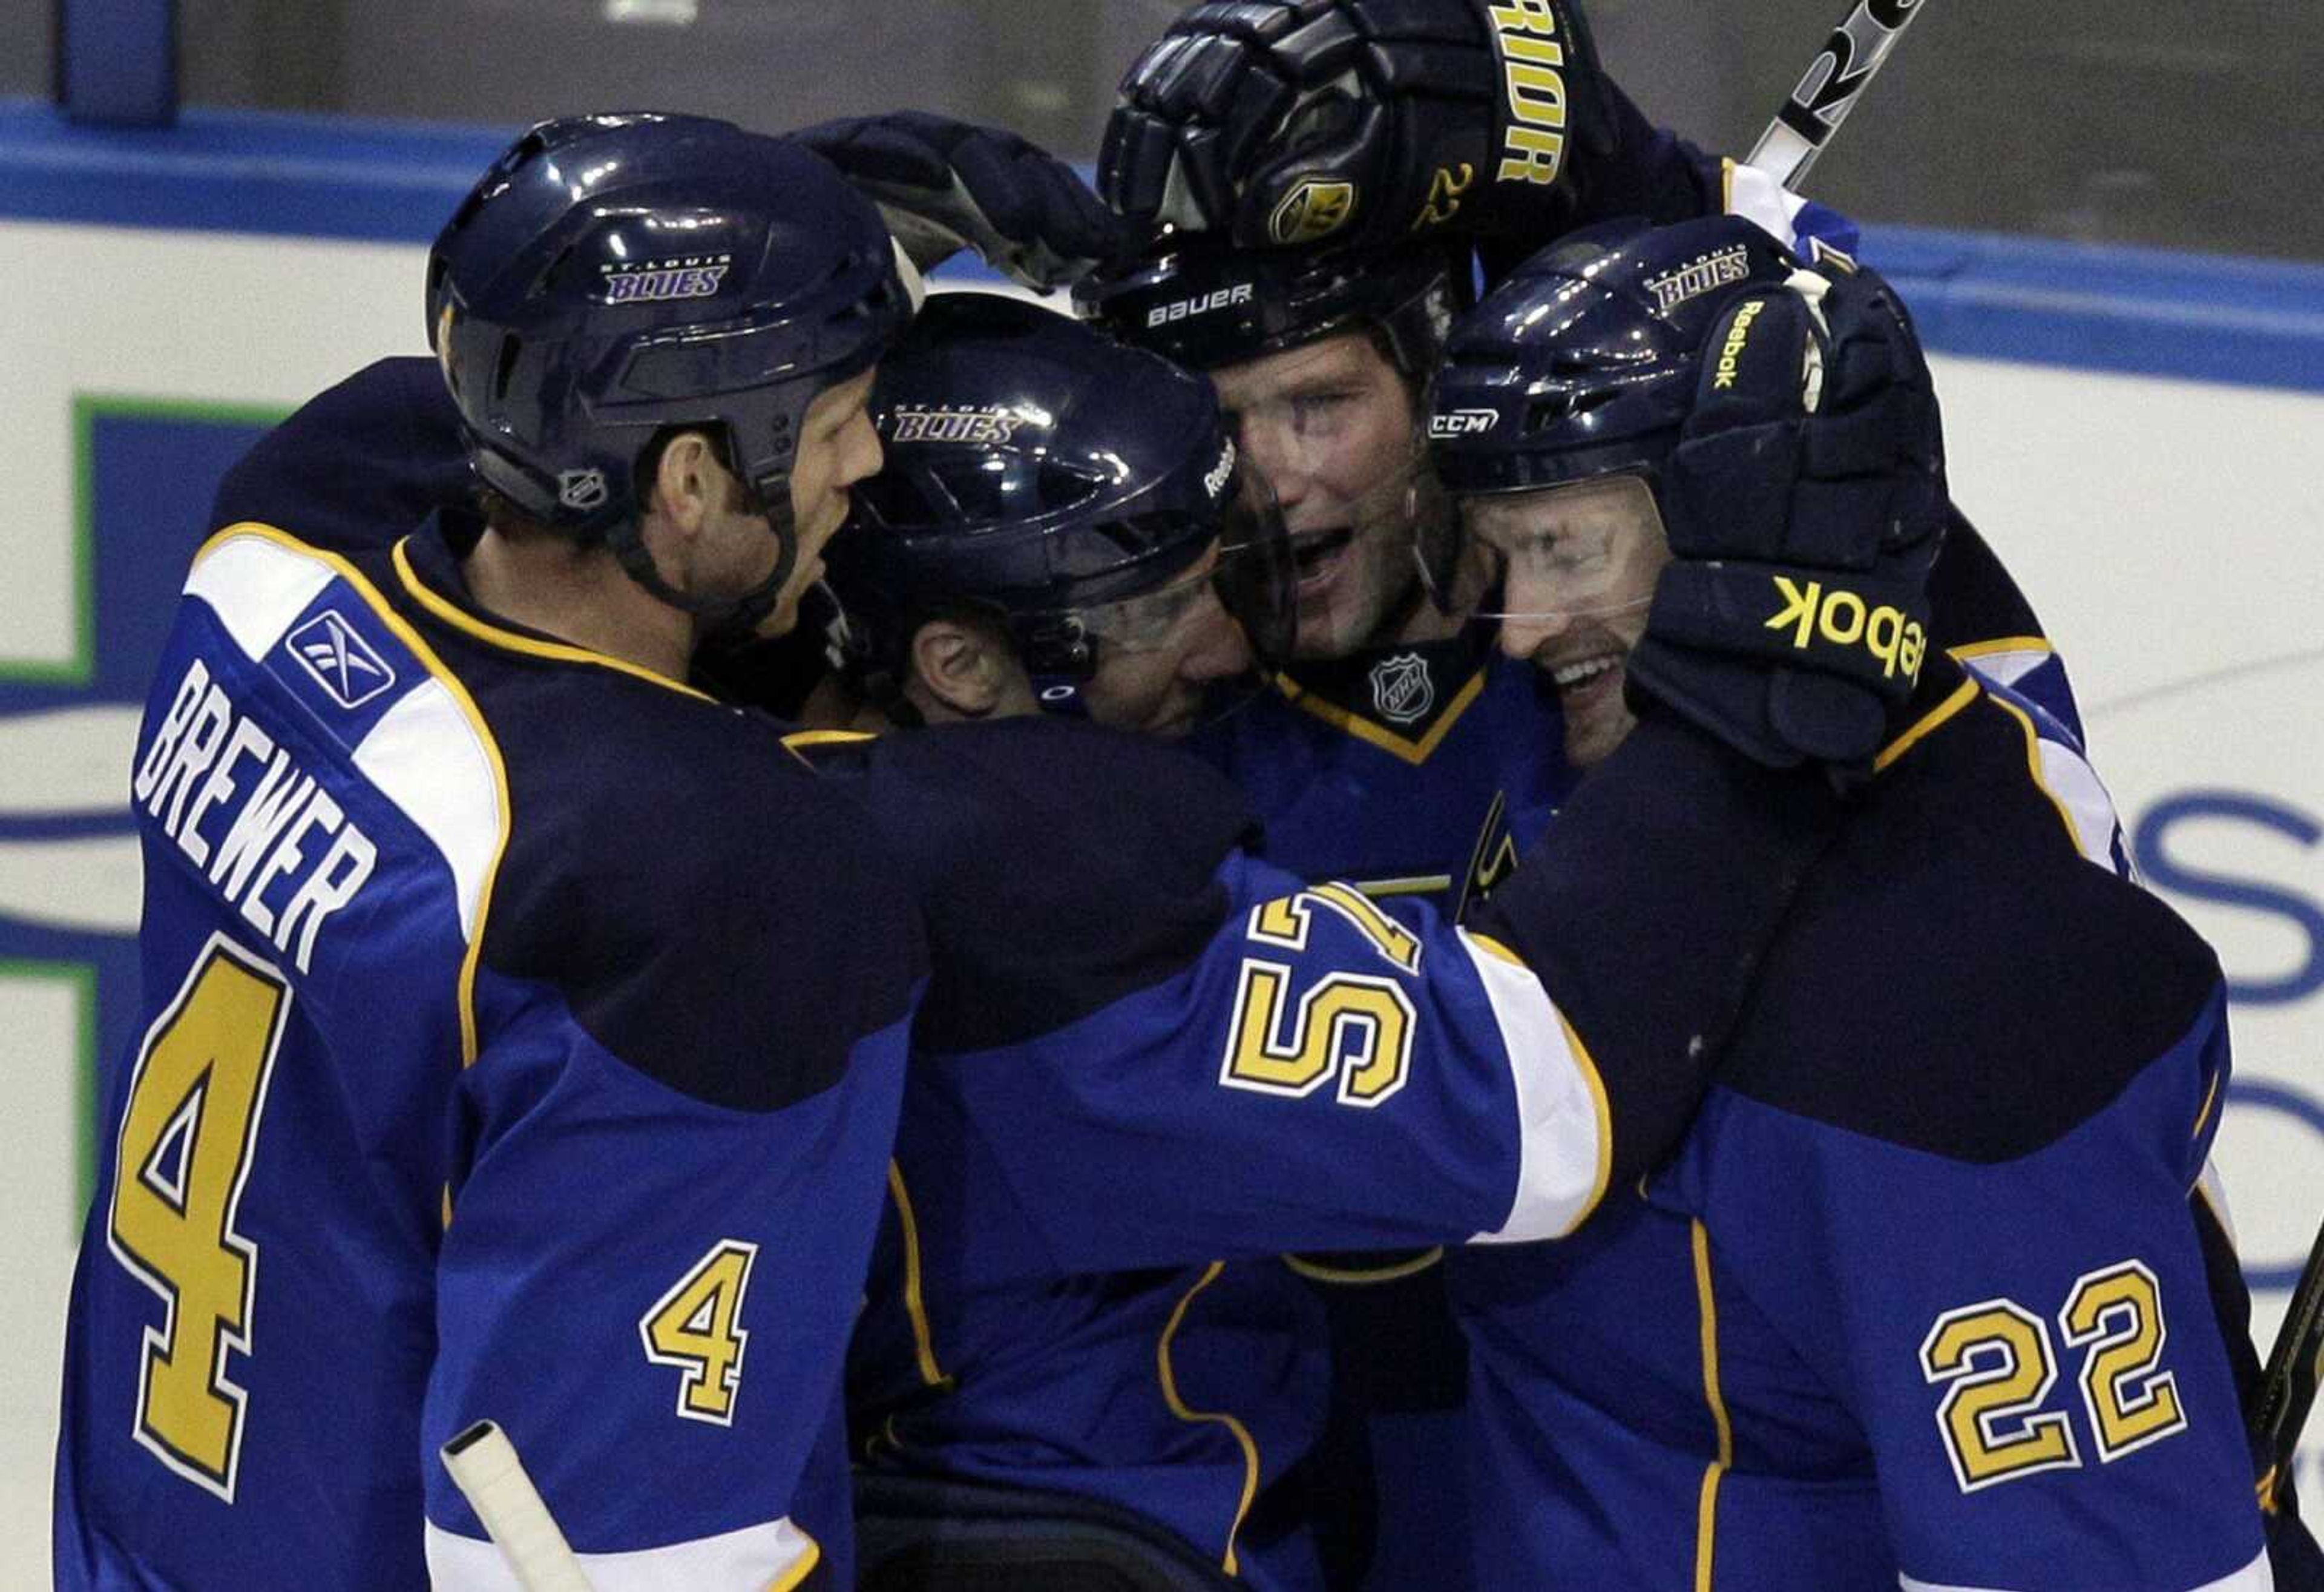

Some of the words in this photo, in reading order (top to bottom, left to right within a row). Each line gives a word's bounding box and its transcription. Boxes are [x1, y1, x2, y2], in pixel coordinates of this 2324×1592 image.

[605, 265, 730, 303] BLUES
[646, 254, 731, 270] LOUIS
[1648, 251, 1751, 310] BLUES
[1147, 283, 1253, 329] BAUER
[1713, 301, 1765, 389] Reebok
[893, 411, 1024, 442] BLUES
[1430, 413, 1491, 434] CCM
[134, 657, 378, 976] BREWER
[1219, 881, 1422, 1109] 57
[107, 929, 295, 1505] 4
[638, 1238, 759, 1428] 4
[1919, 1257, 2188, 1495] 22
